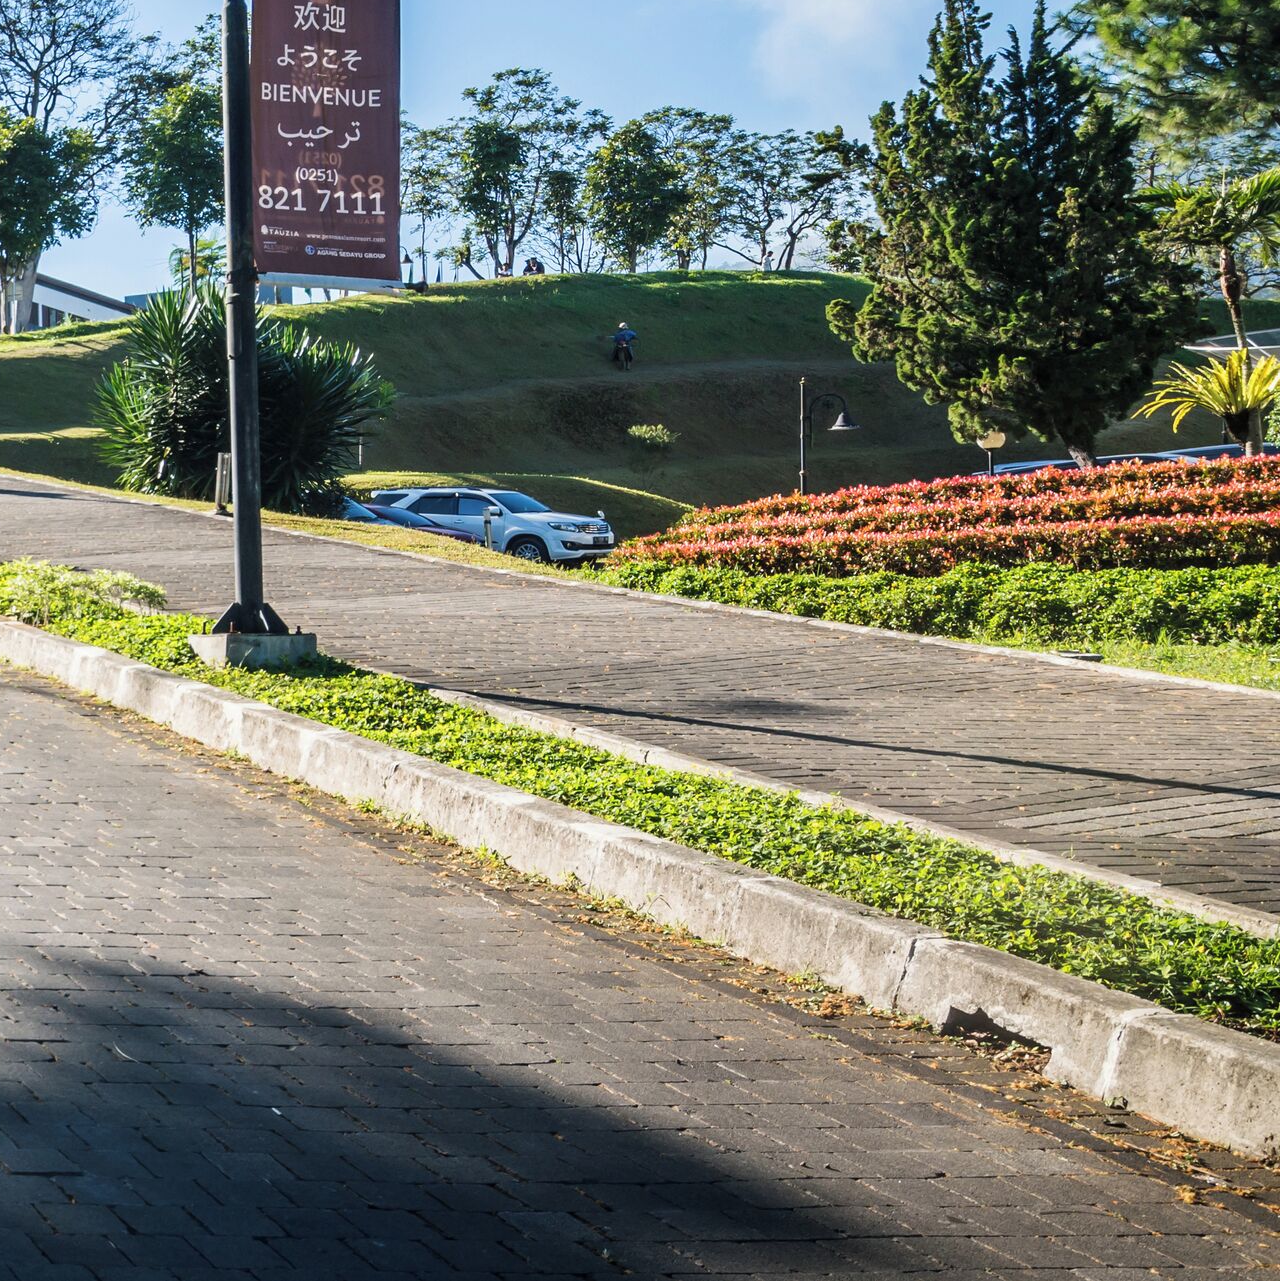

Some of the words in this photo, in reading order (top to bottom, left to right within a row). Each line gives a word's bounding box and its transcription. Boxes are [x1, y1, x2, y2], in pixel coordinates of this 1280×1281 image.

[293, 1, 347, 34] 欢迎
[276, 43, 363, 72] ようこそ
[260, 82, 382, 108] BIENVENUE
[295, 166, 339, 186] (0251)
[258, 184, 307, 212] 821
[316, 189, 386, 215] 7111
[269, 228, 300, 238] TAUZIA
